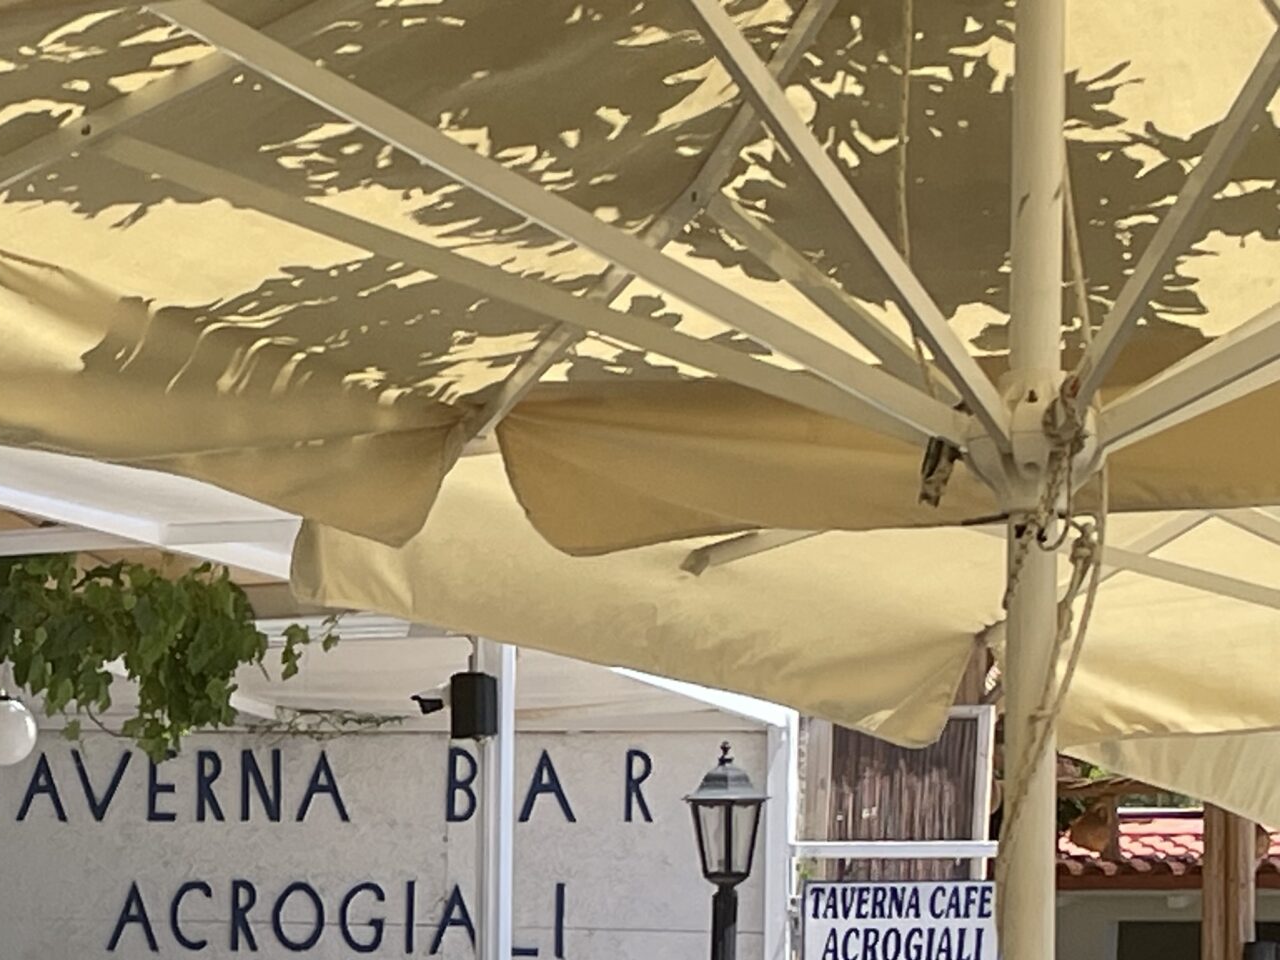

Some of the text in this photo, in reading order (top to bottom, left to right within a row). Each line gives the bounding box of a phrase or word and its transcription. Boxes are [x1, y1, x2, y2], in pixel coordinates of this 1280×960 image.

[446, 747, 655, 824] BAR
[106, 879, 567, 960] ACROGIAI
[810, 886, 993, 919] TAVERNA CAFE
